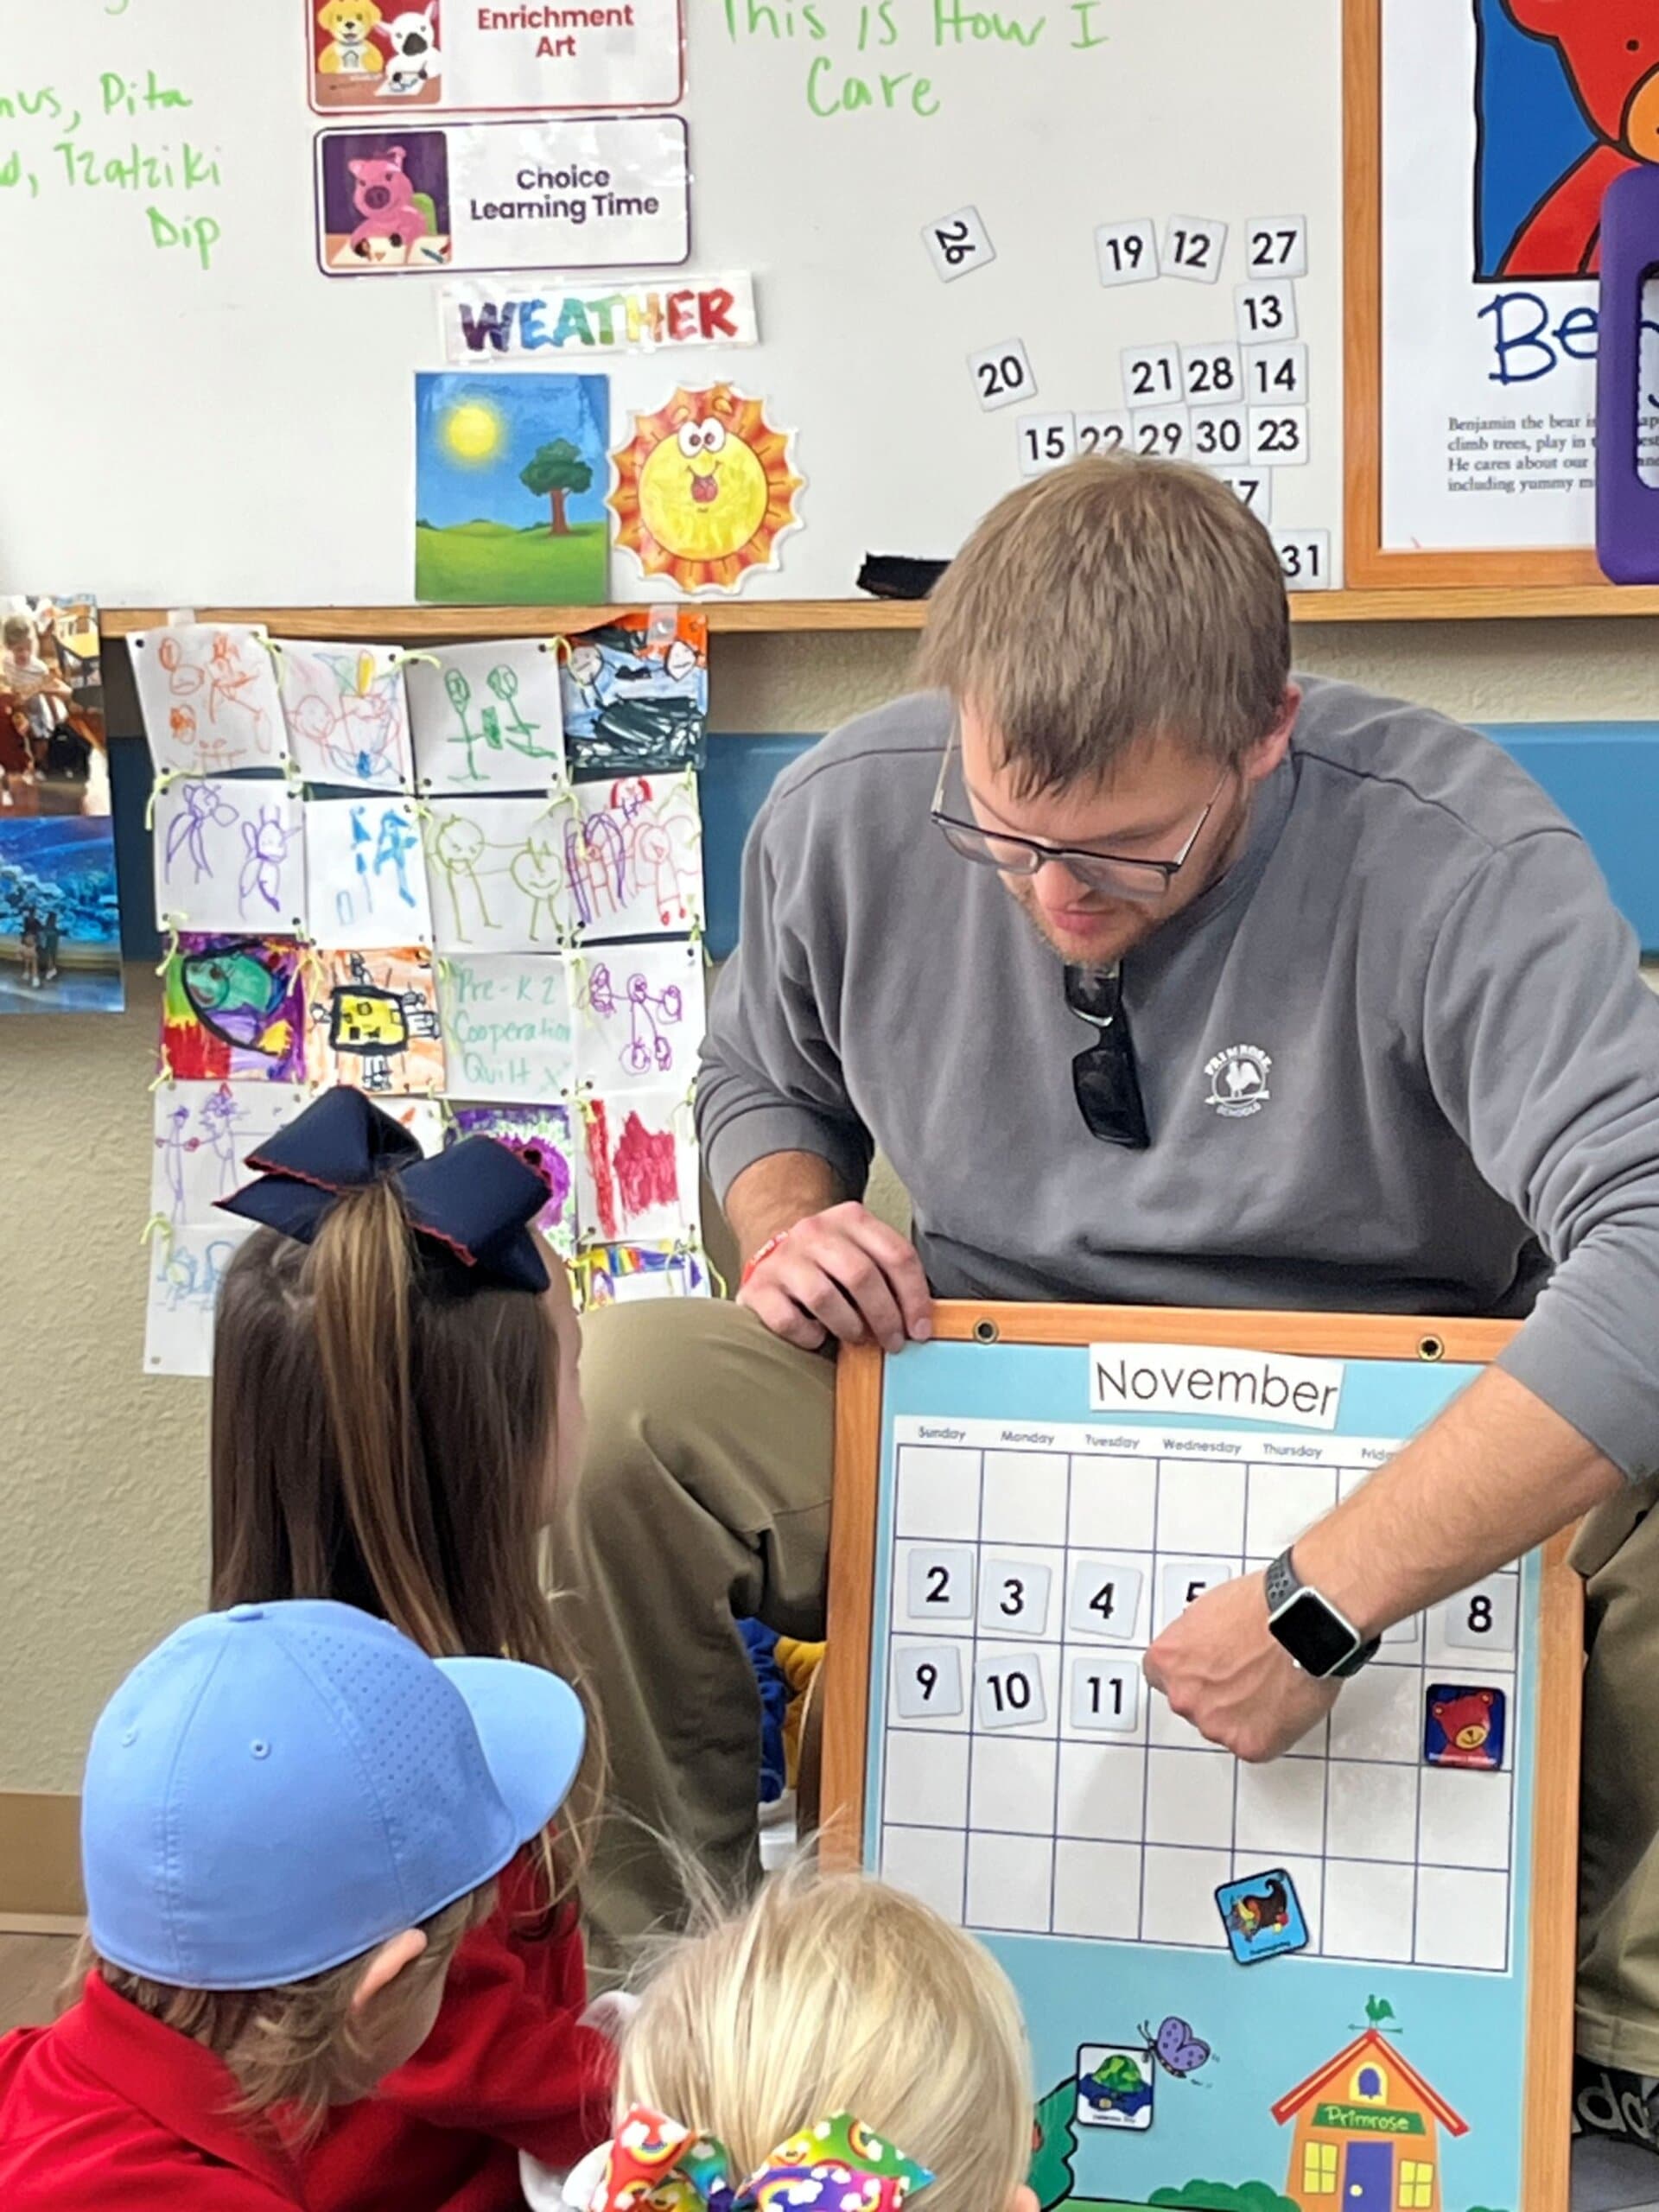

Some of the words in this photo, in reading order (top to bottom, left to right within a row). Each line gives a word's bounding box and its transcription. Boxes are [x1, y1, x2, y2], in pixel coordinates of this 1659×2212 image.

[477, 3, 634, 30] Enrichment
[934, 0, 1046, 47] How
[1071, 2, 1109, 48] I
[535, 35, 576, 58] Art
[99, 69, 193, 116] Pita
[806, 56, 941, 118] Care
[53, 142, 221, 190] Tzatziki
[516, 164, 610, 190] Choice
[470, 194, 587, 225] Learning
[592, 192, 660, 217] Time
[145, 205, 221, 270] Dip
[934, 219, 976, 265] 26
[1106, 234, 1144, 272] 19
[1173, 230, 1211, 268] 12
[1251, 229, 1298, 266] 27
[458, 287, 739, 353] WEATHER
[1243, 294, 1283, 331] 13
[977, 354, 1024, 397] 20
[1130, 358, 1172, 395] 21
[1187, 356, 1234, 393] 28
[1254, 357, 1297, 393] 14
[1080, 425, 1124, 456] 22
[1138, 422, 1183, 456] 29
[1196, 418, 1243, 454] 30
[1257, 417, 1301, 452] 23
[1446, 416, 1516, 433] Benjamin
[1521, 415, 1544, 430] the
[1548, 413, 1580, 429] bear
[1025, 426, 1065, 461] 15
[1447, 435, 1489, 452] climb
[1493, 437, 1531, 452] trees,
[1536, 434, 1567, 452] play
[1572, 435, 1586, 448] in
[1447, 456, 1470, 472] He
[1474, 457, 1511, 471] cares
[1516, 455, 1557, 471] about
[1562, 458, 1588, 469] our
[1224, 479, 1259, 507] 7
[1447, 476, 1515, 493] including
[1520, 478, 1573, 493] yummy
[1281, 543, 1319, 577] 31
[454, 1008, 572, 1054] Cooperation
[463, 1051, 531, 1086] Quilt
[1096, 1359, 1338, 1416] November
[918, 1426, 967, 1441] Sunday
[1001, 1430, 1056, 1446] Monday
[1085, 1433, 1141, 1450] Tuesday
[1162, 1438, 1243, 1455] Wednesday
[1262, 1442, 1324, 1460] Thursday
[1361, 1447, 1400, 1461] Frida
[925, 1566, 950, 1604] 2
[999, 1579, 1026, 1616] 3
[1088, 1581, 1116, 1620] 4
[1468, 1594, 1493, 1634] 8
[915, 1663, 938, 1700] 9
[987, 1671, 1032, 1712] 10
[1086, 1675, 1123, 1715] 11
[1325, 2104, 1410, 2132] Primrose
